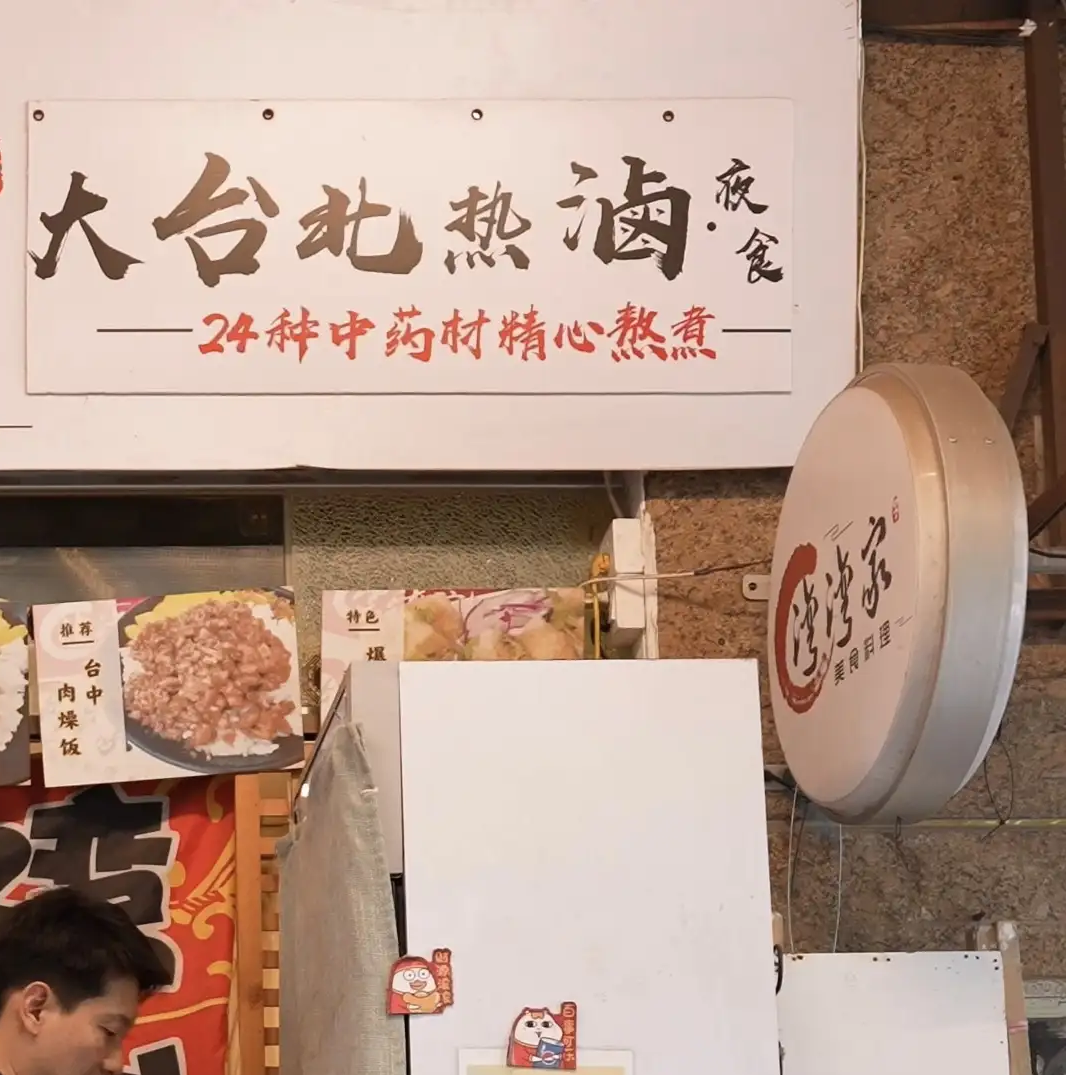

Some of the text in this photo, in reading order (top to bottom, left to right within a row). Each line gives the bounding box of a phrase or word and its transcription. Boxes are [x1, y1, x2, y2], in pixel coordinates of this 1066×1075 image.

[199, 303, 717, 363] 24种中药材精心熬煮
[59, 621, 94, 637] 推荐
[346, 609, 379, 624] 特色
[84, 659, 103, 705] 台中
[57, 686, 83, 757] 肉燥饭
